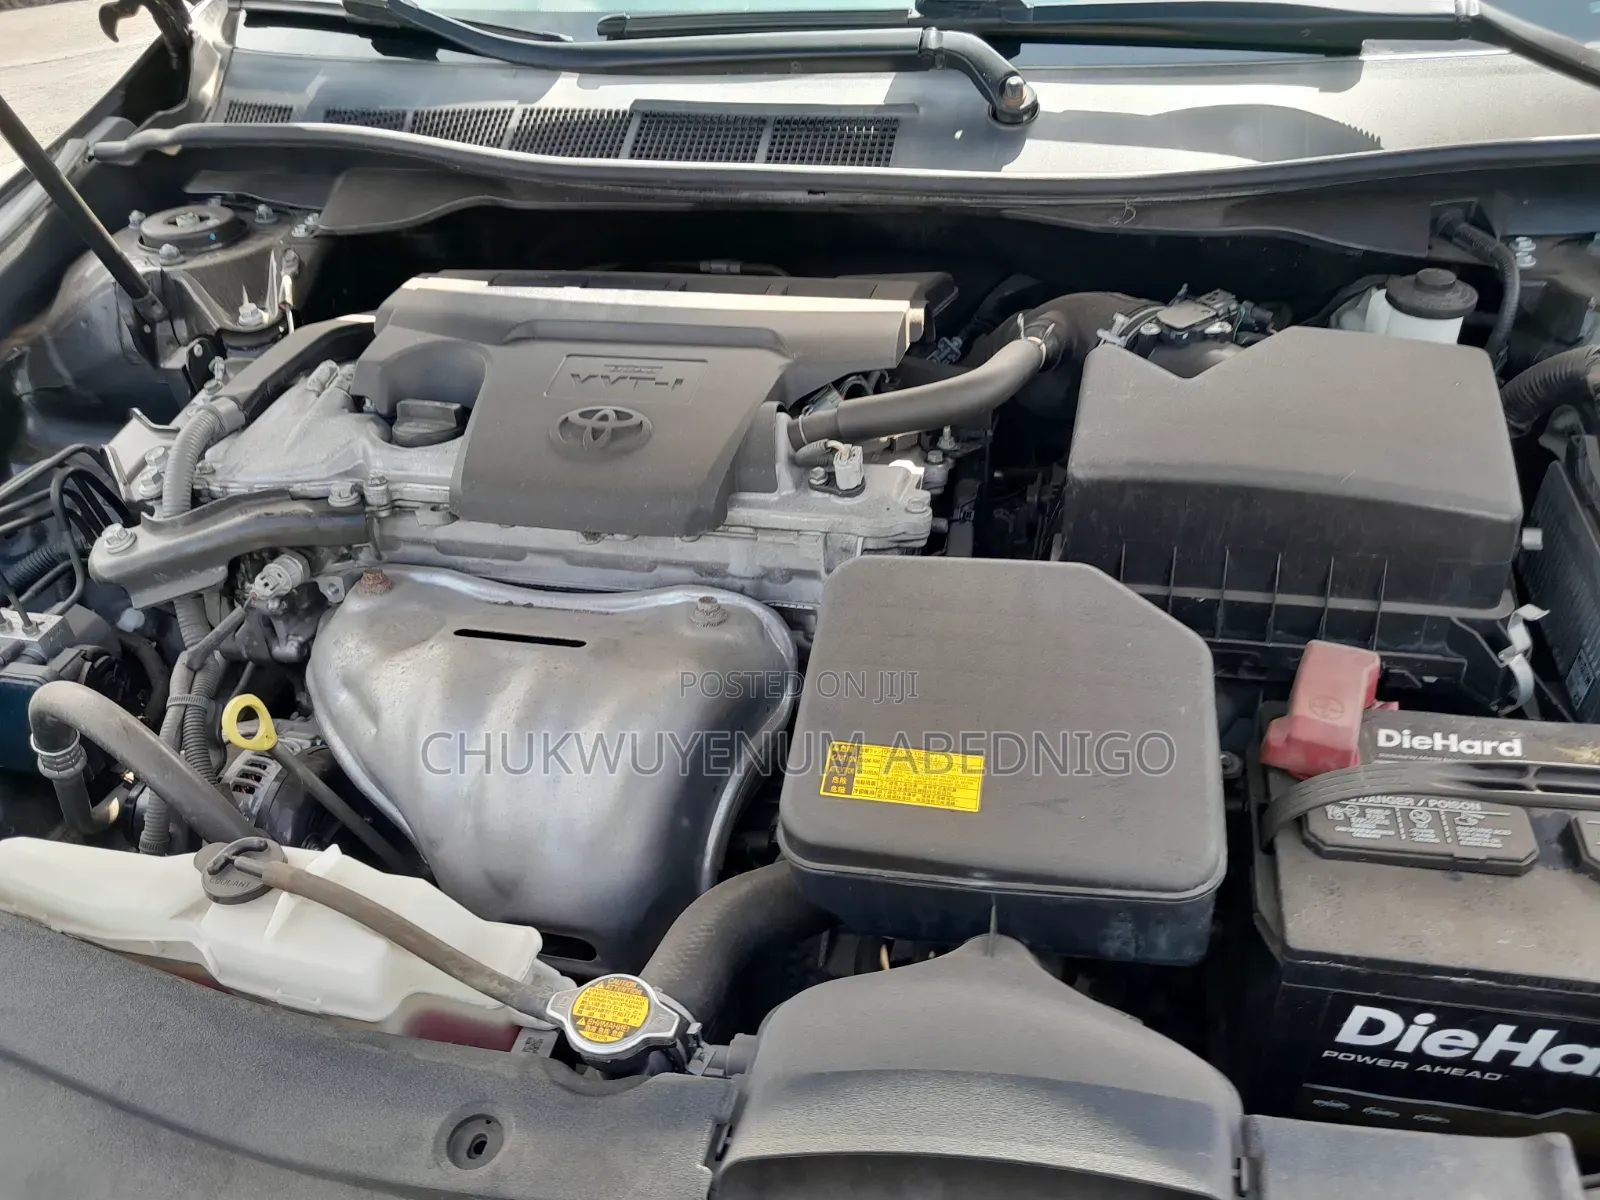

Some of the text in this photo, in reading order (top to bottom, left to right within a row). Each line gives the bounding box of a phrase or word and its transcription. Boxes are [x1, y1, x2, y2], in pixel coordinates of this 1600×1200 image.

[1376, 728, 1523, 758] DieHard
[1428, 799, 1482, 811] POISON
[1334, 1004, 1600, 1078] DieHa
[1321, 1049, 1504, 1081] POWER AHEAD
